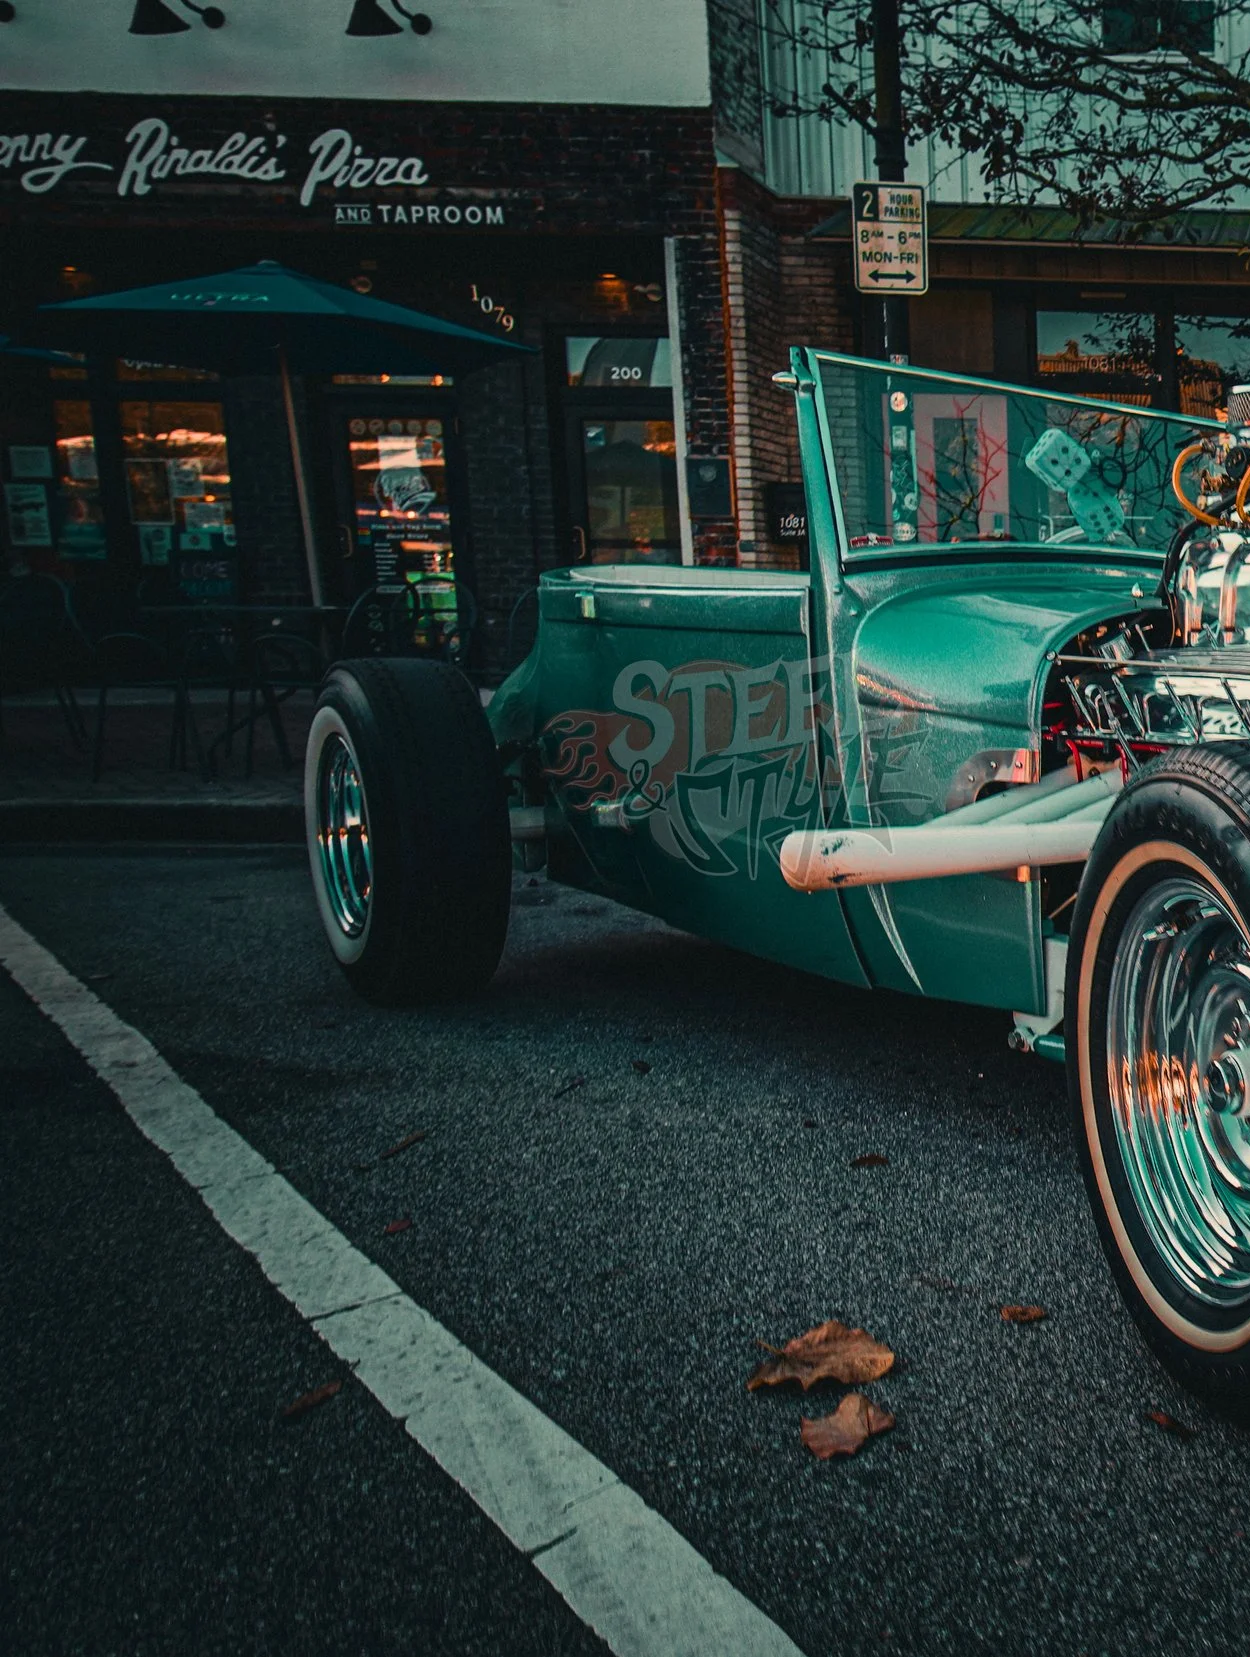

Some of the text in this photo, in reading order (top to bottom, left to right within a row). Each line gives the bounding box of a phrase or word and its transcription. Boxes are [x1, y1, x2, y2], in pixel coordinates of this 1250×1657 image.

[117, 116, 286, 197] Rinaldi's
[300, 127, 429, 207] Pizza
[862, 191, 873, 217] 2
[890, 194, 913, 204] HOUR
[335, 204, 506, 225] AND TAPROOM
[884, 207, 920, 218] PARKING
[862, 252, 918, 264] MON-FRI
[470, 283, 515, 333] 1079
[611, 366, 642, 381] 200
[780, 516, 805, 528] 1081
